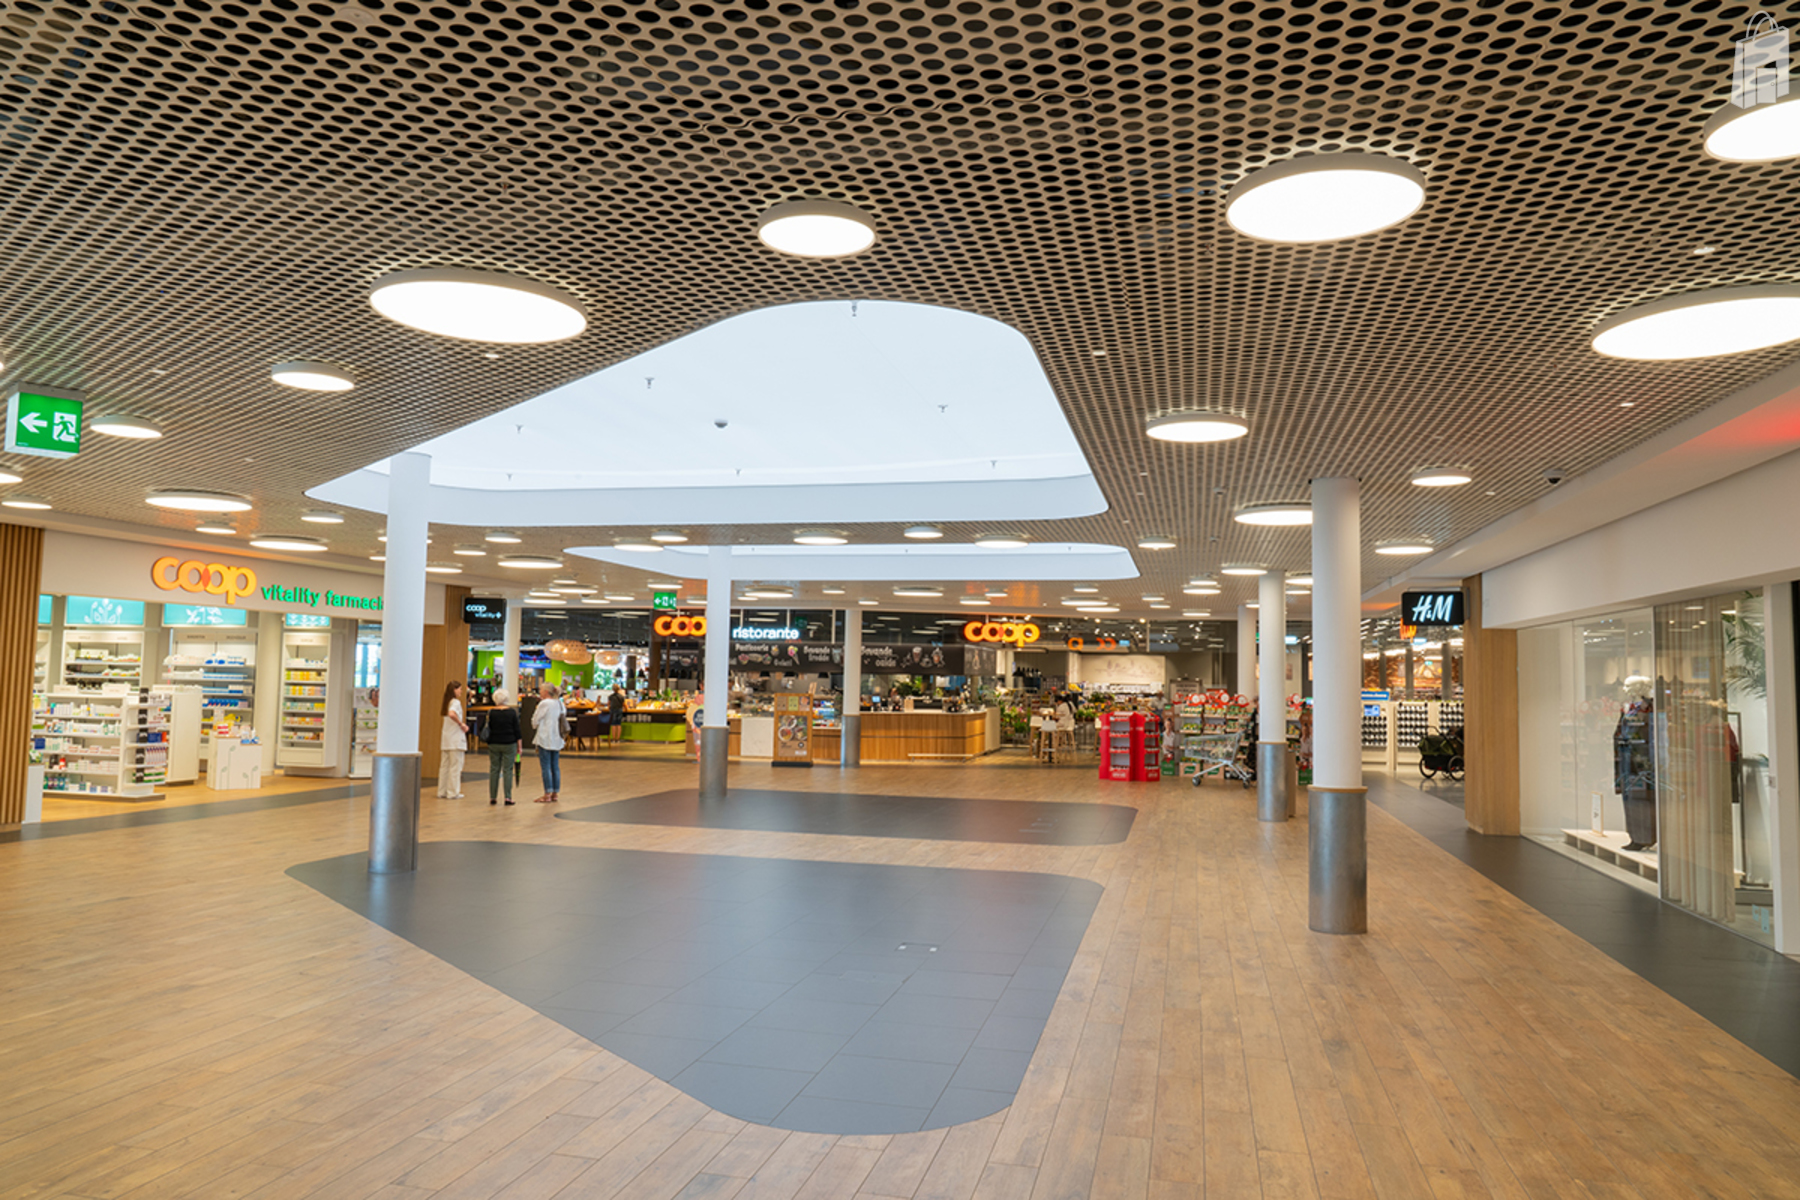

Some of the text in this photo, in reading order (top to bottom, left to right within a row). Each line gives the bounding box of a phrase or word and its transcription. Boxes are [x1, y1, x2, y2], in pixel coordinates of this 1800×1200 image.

[152, 556, 384, 611] coop vitality farmaci
[466, 604, 487, 614] coop
[1412, 594, 1454, 623] H&M
[653, 615, 708, 637] coo
[732, 626, 800, 640] ristorante
[963, 621, 1041, 647] coop
